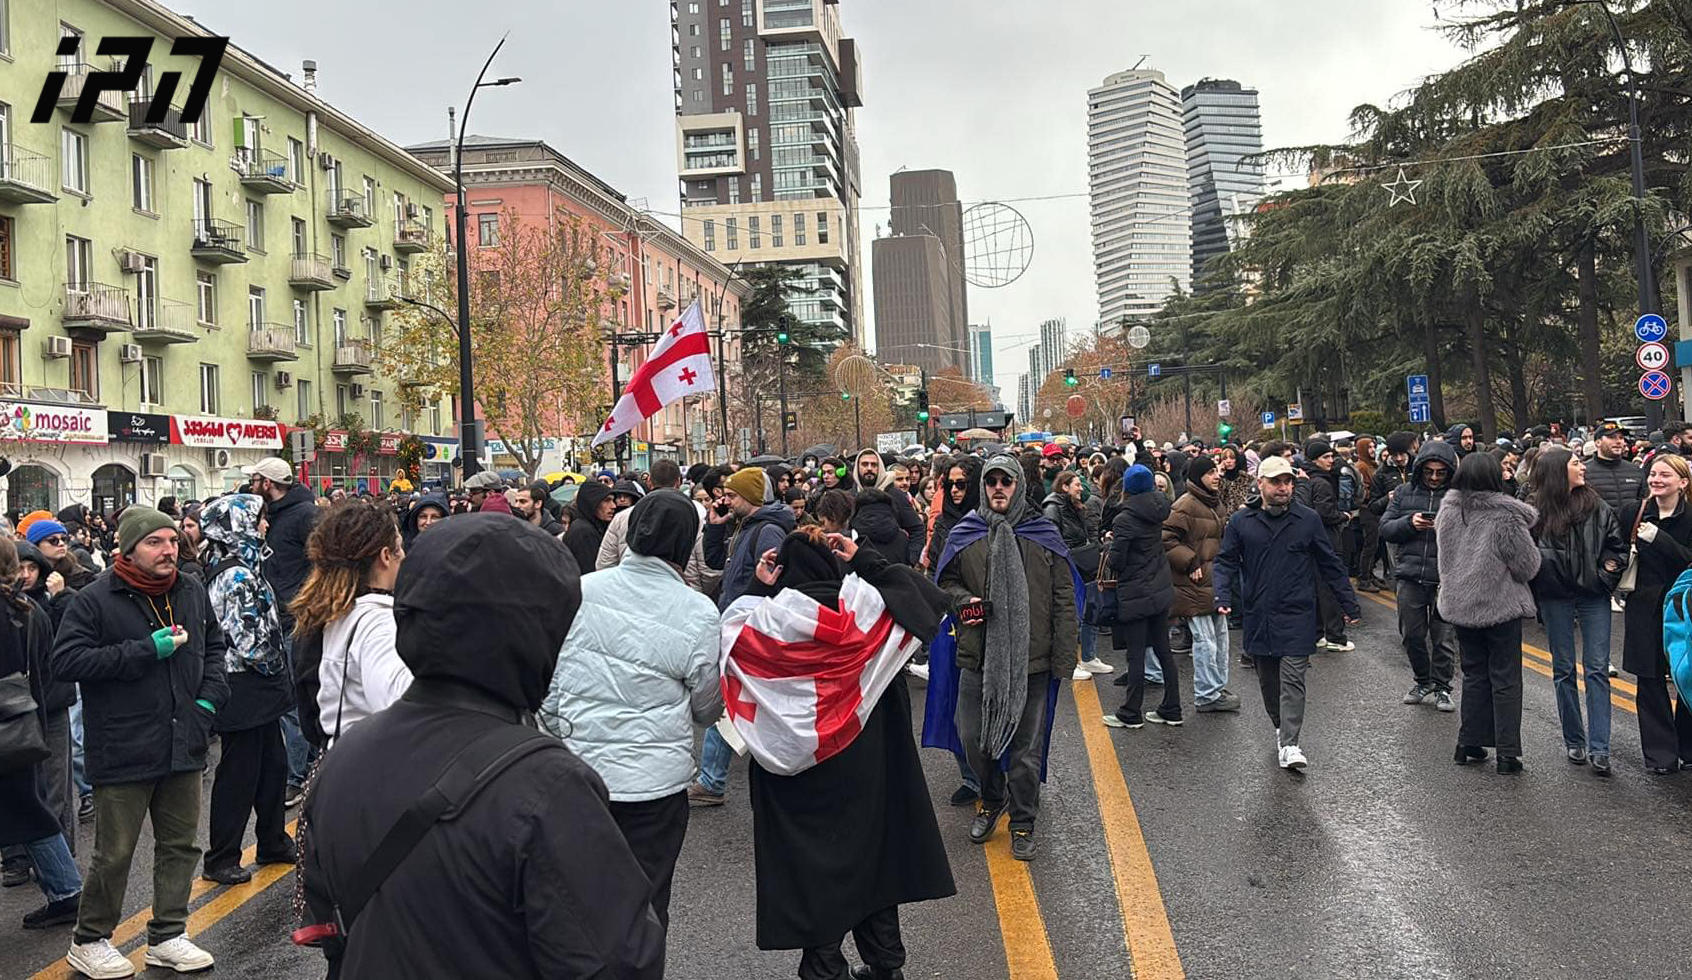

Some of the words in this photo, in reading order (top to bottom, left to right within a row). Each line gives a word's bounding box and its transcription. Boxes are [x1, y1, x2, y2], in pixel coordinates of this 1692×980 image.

[1643, 351, 1662, 363] 40
[35, 411, 92, 432] mosaic
[1265, 413, 1272, 423] P
[243, 424, 277, 440] AVERSI
